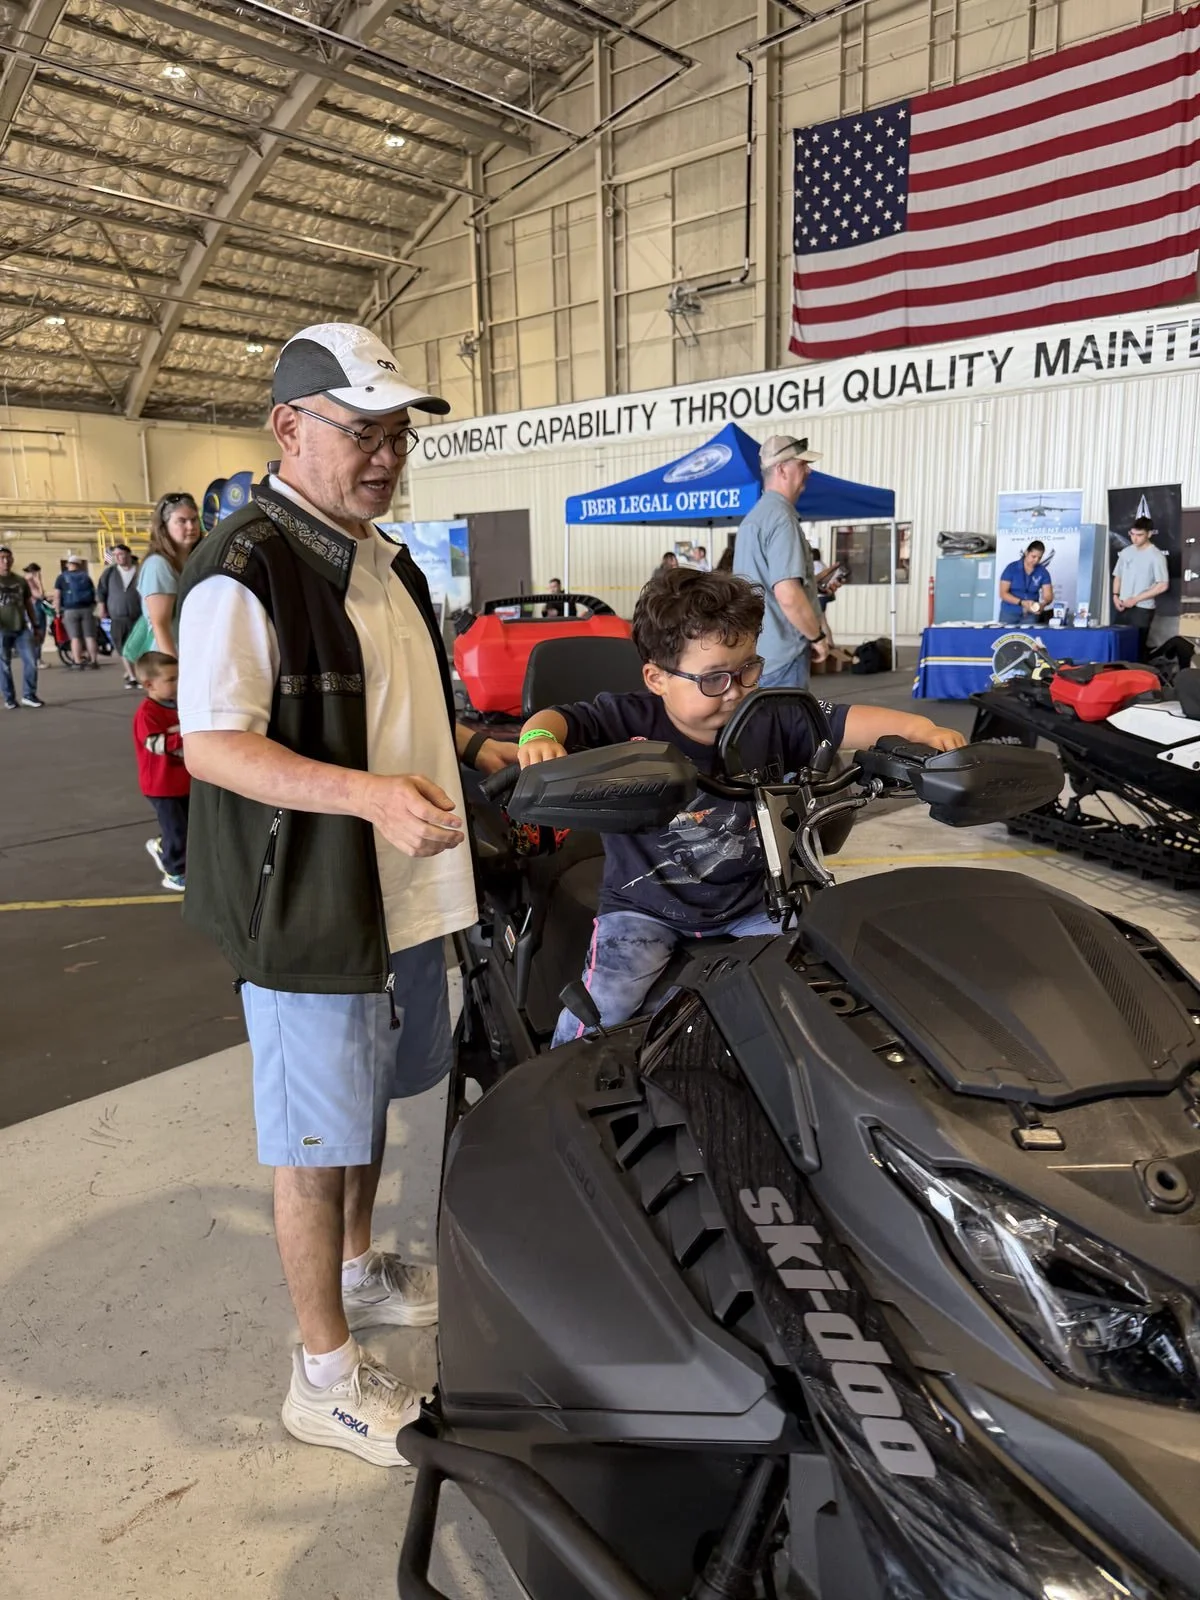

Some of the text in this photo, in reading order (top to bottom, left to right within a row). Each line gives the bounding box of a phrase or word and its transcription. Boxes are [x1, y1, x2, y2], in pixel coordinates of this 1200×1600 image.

[423, 424, 507, 461] COMBAT
[517, 402, 657, 447] CAPABILITY
[671, 376, 825, 426] THROUGH
[843, 346, 1014, 403] QUALITY
[579, 488, 741, 520] JBER LEGAL OFFICE
[332, 1407, 369, 1437] HOKA
